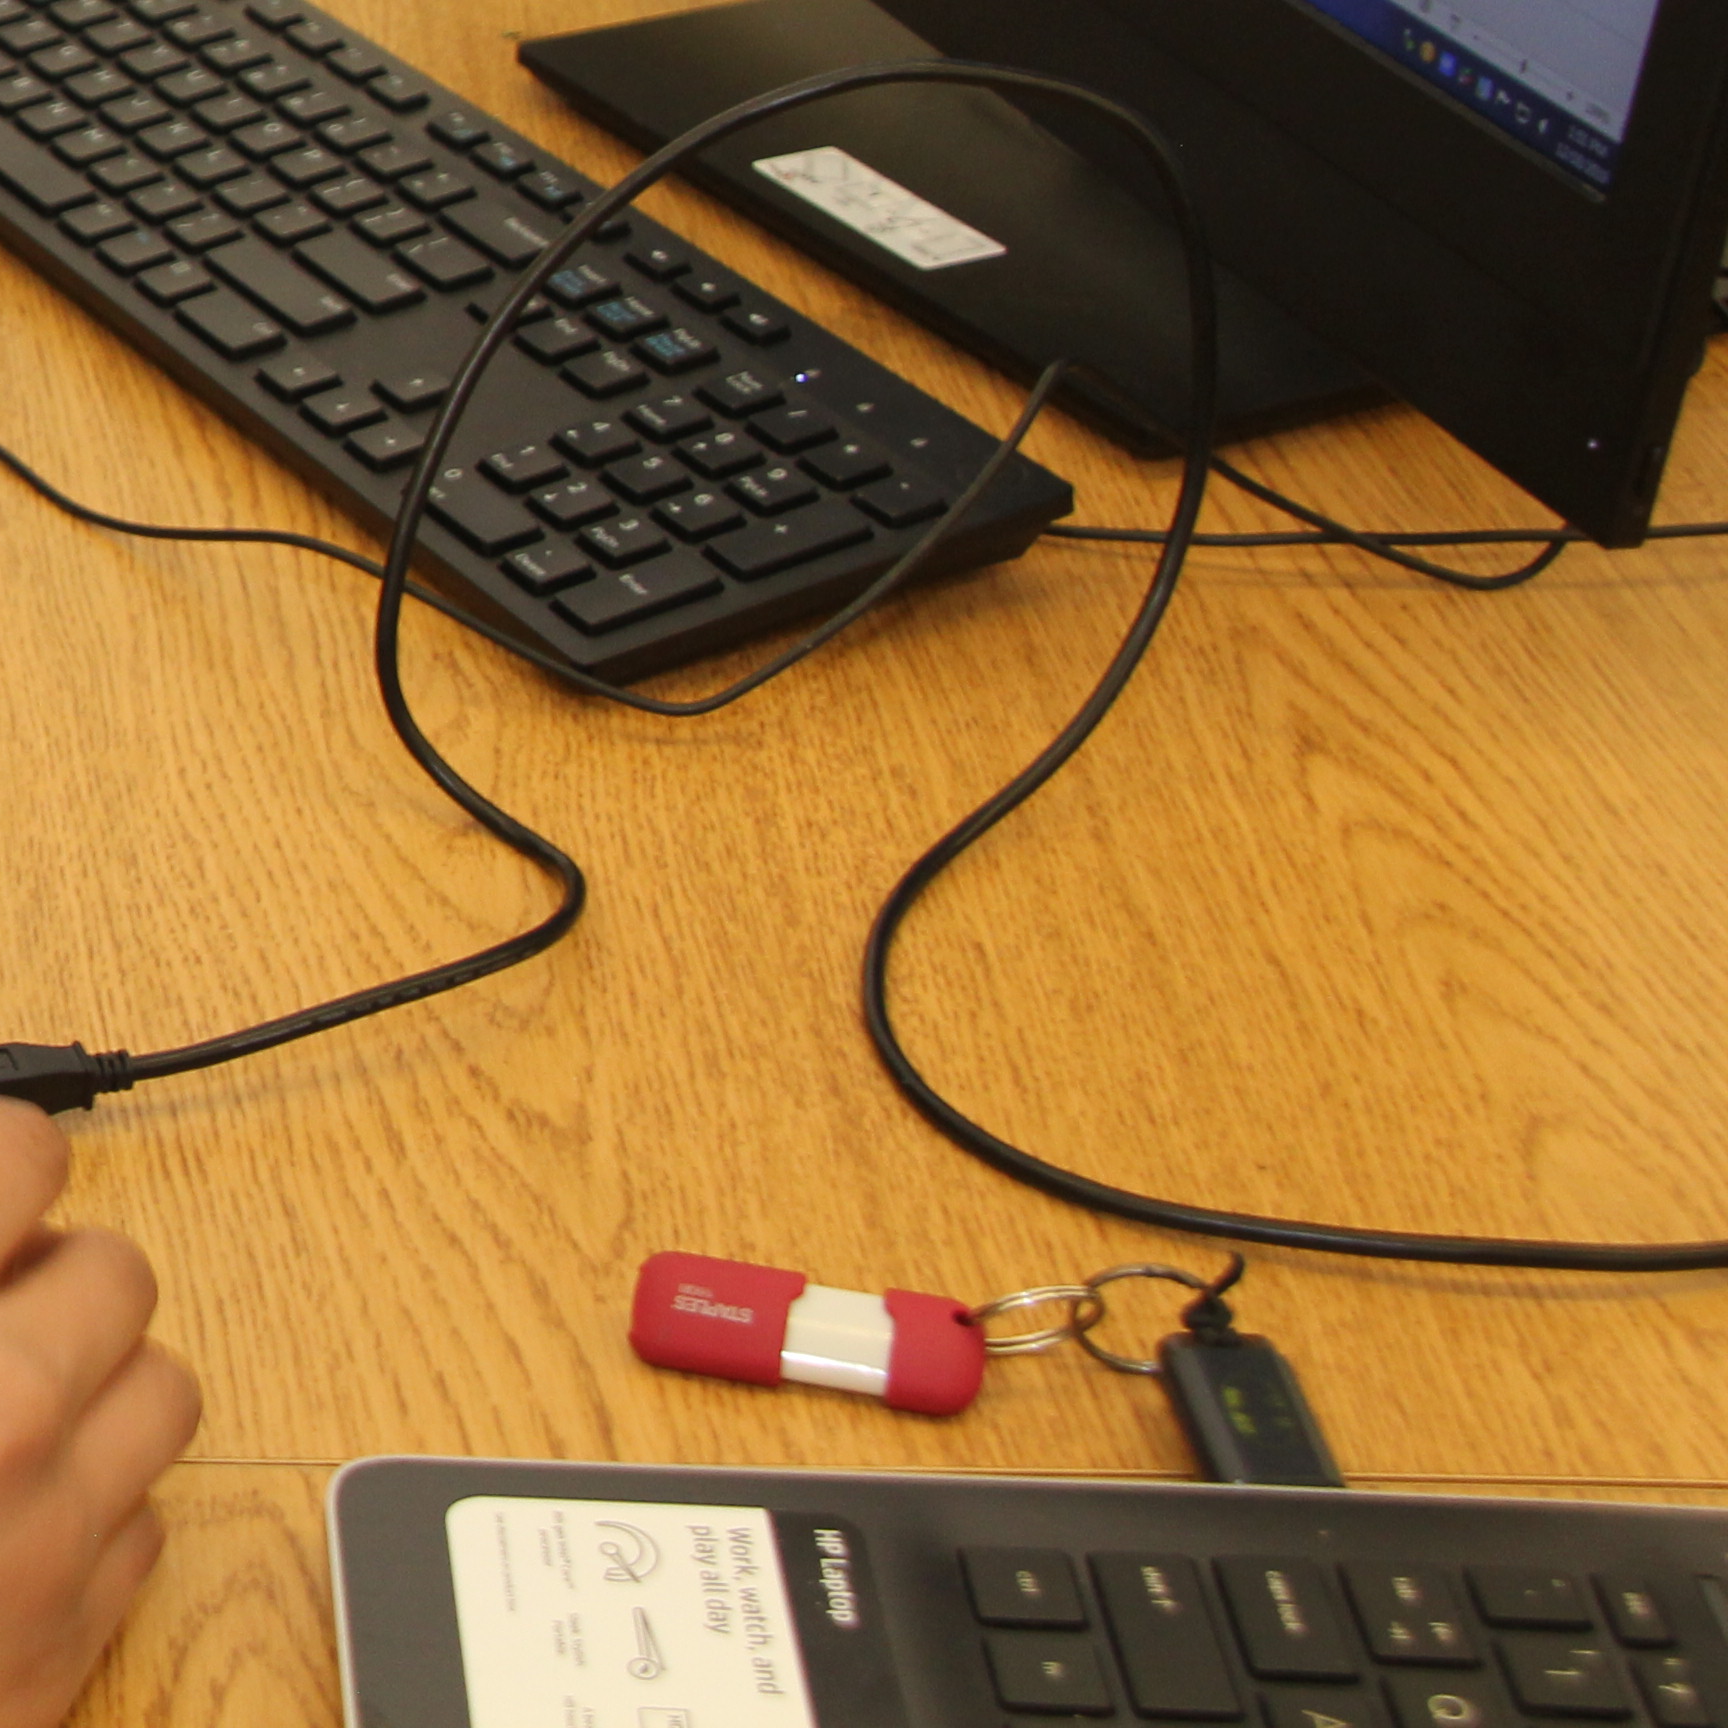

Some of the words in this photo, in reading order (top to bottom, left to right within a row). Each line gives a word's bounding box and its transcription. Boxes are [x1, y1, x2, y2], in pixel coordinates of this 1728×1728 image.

[670, 1293, 754, 1326] STAPLES
[685, 1524, 720, 1566] play
[726, 1526, 760, 1581] Work,
[813, 1528, 851, 1558] HP
[698, 1569, 730, 1593] all
[818, 1557, 863, 1629] Laptop
[702, 1597, 733, 1635] day
[738, 1586, 774, 1651] watch,
[751, 1656, 786, 1695] and
